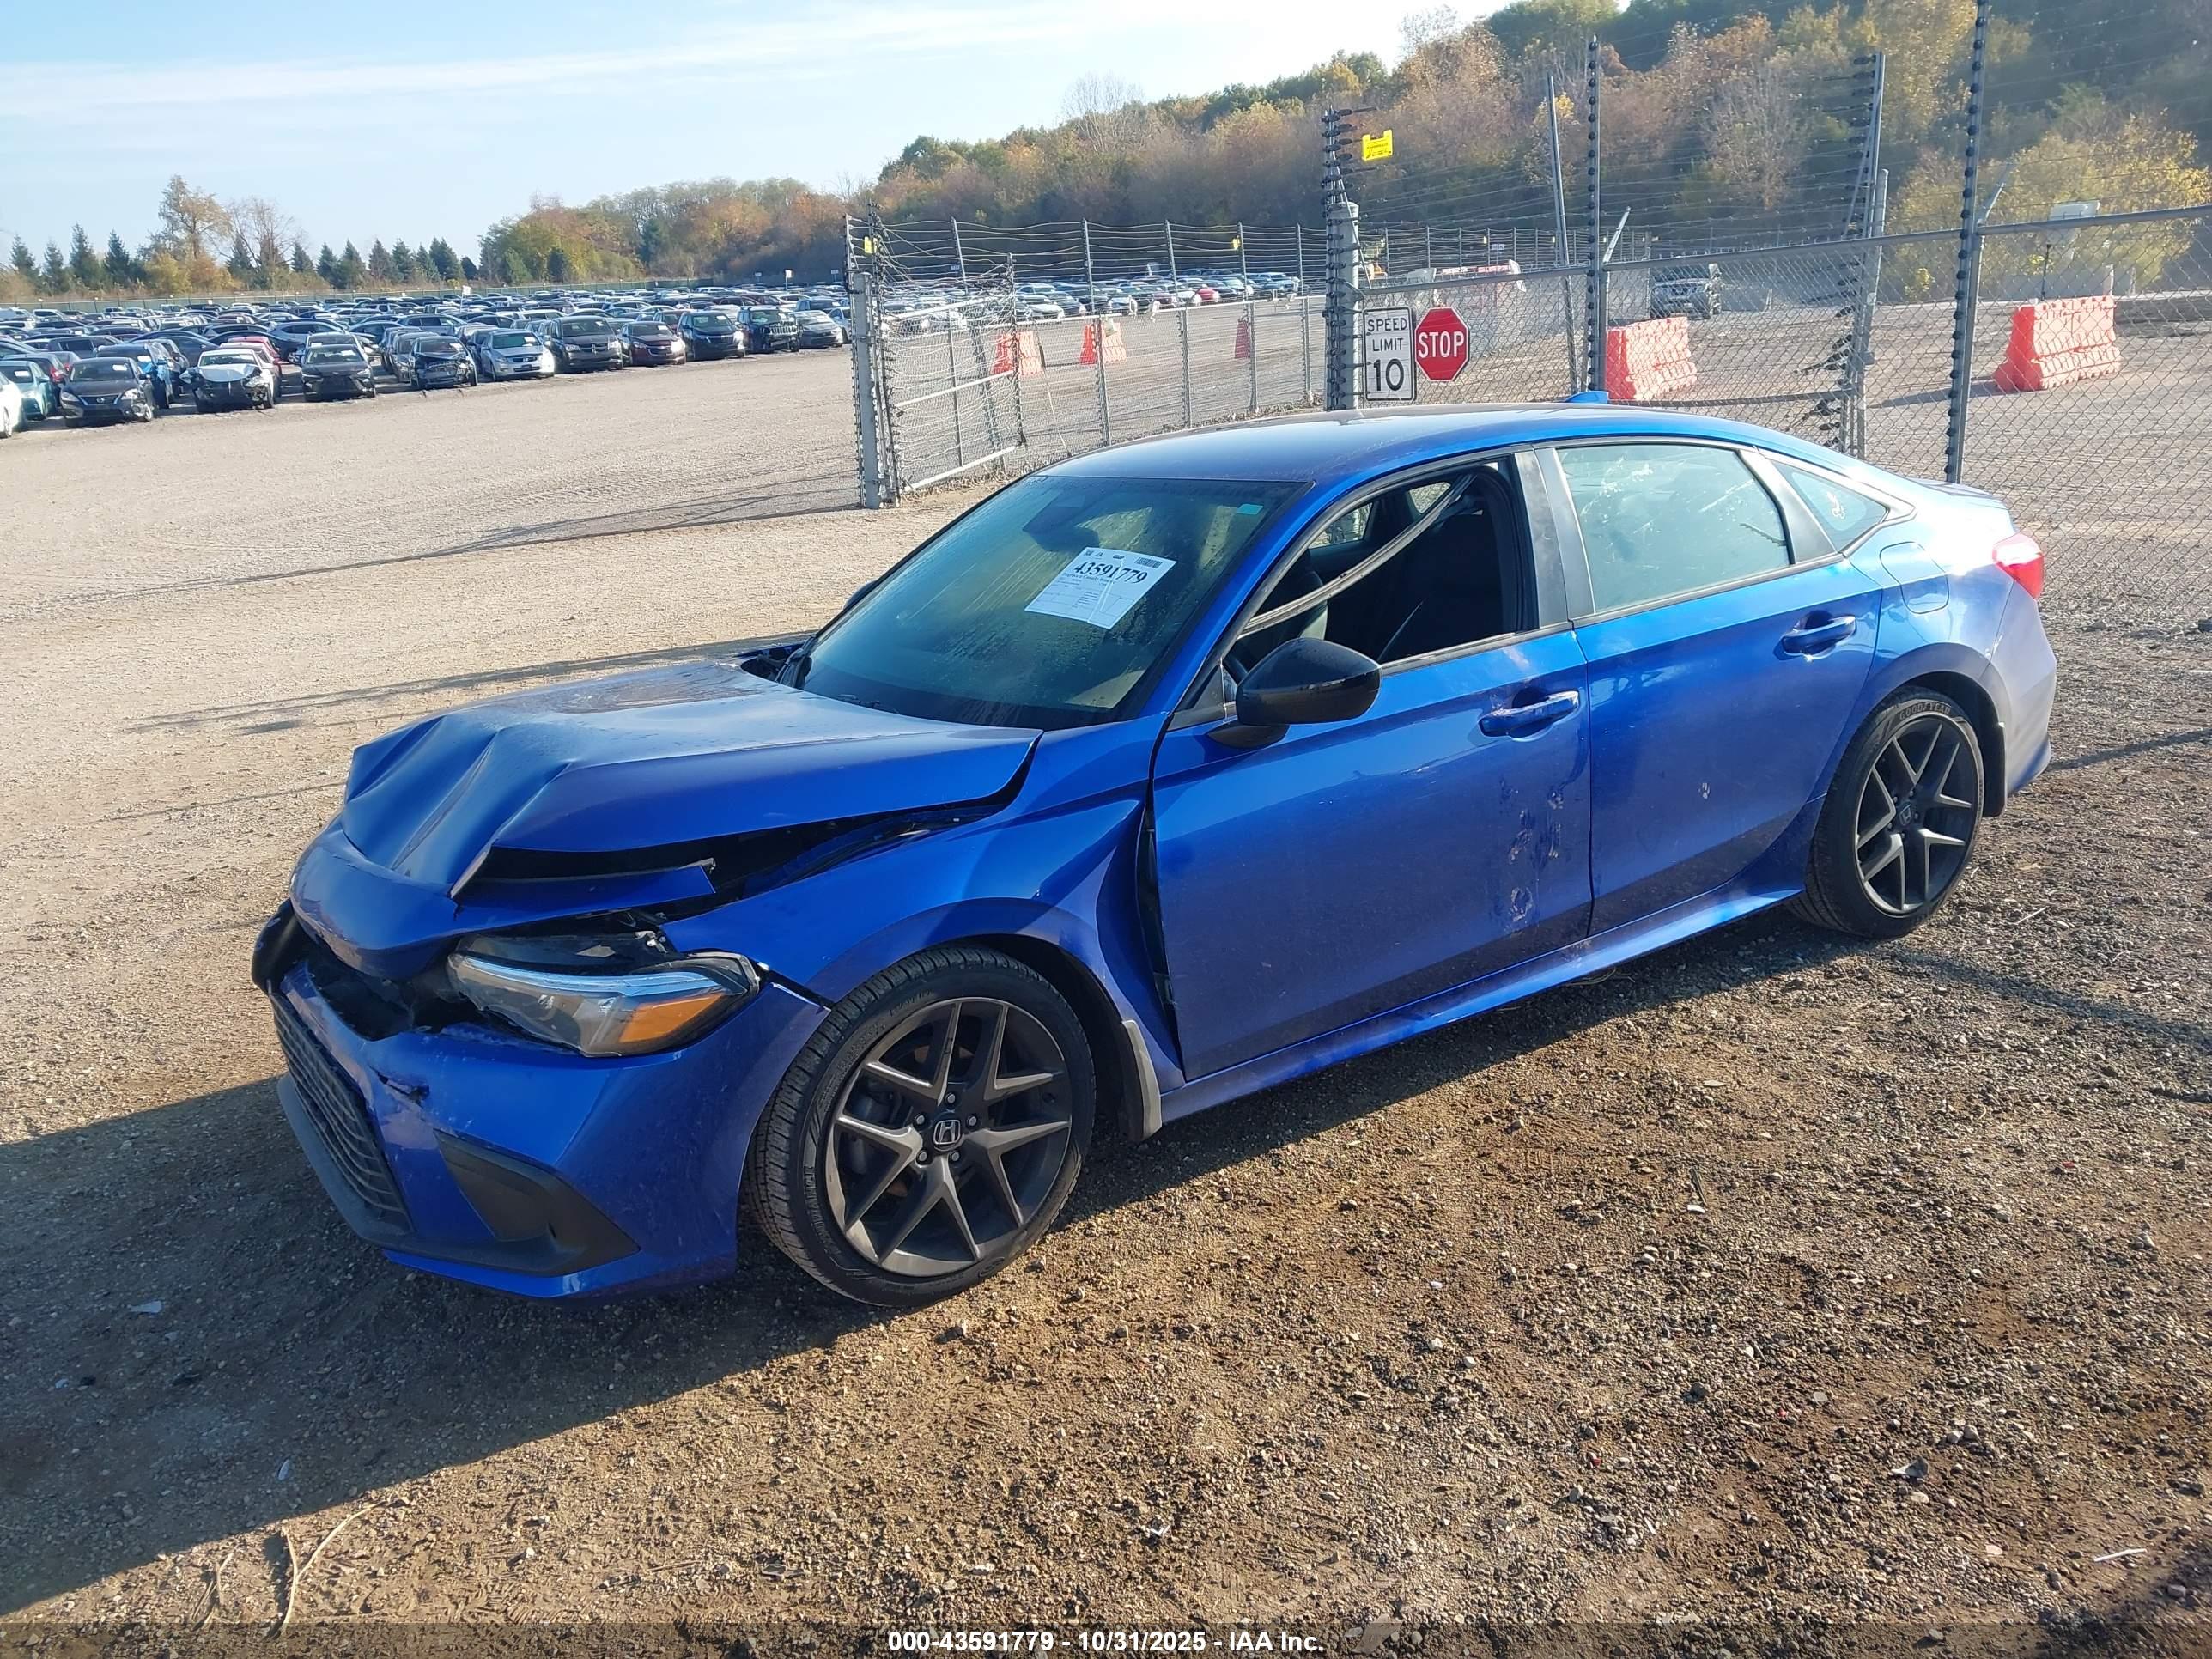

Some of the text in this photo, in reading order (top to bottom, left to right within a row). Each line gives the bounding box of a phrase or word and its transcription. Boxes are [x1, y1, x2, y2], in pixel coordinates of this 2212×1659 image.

[1367, 318, 1407, 331] SPEED
[1372, 338, 1404, 351] LIMIT
[1418, 331, 1464, 358] STOP
[1374, 359, 1404, 391] 10
[1073, 561, 1148, 584] 43591779
